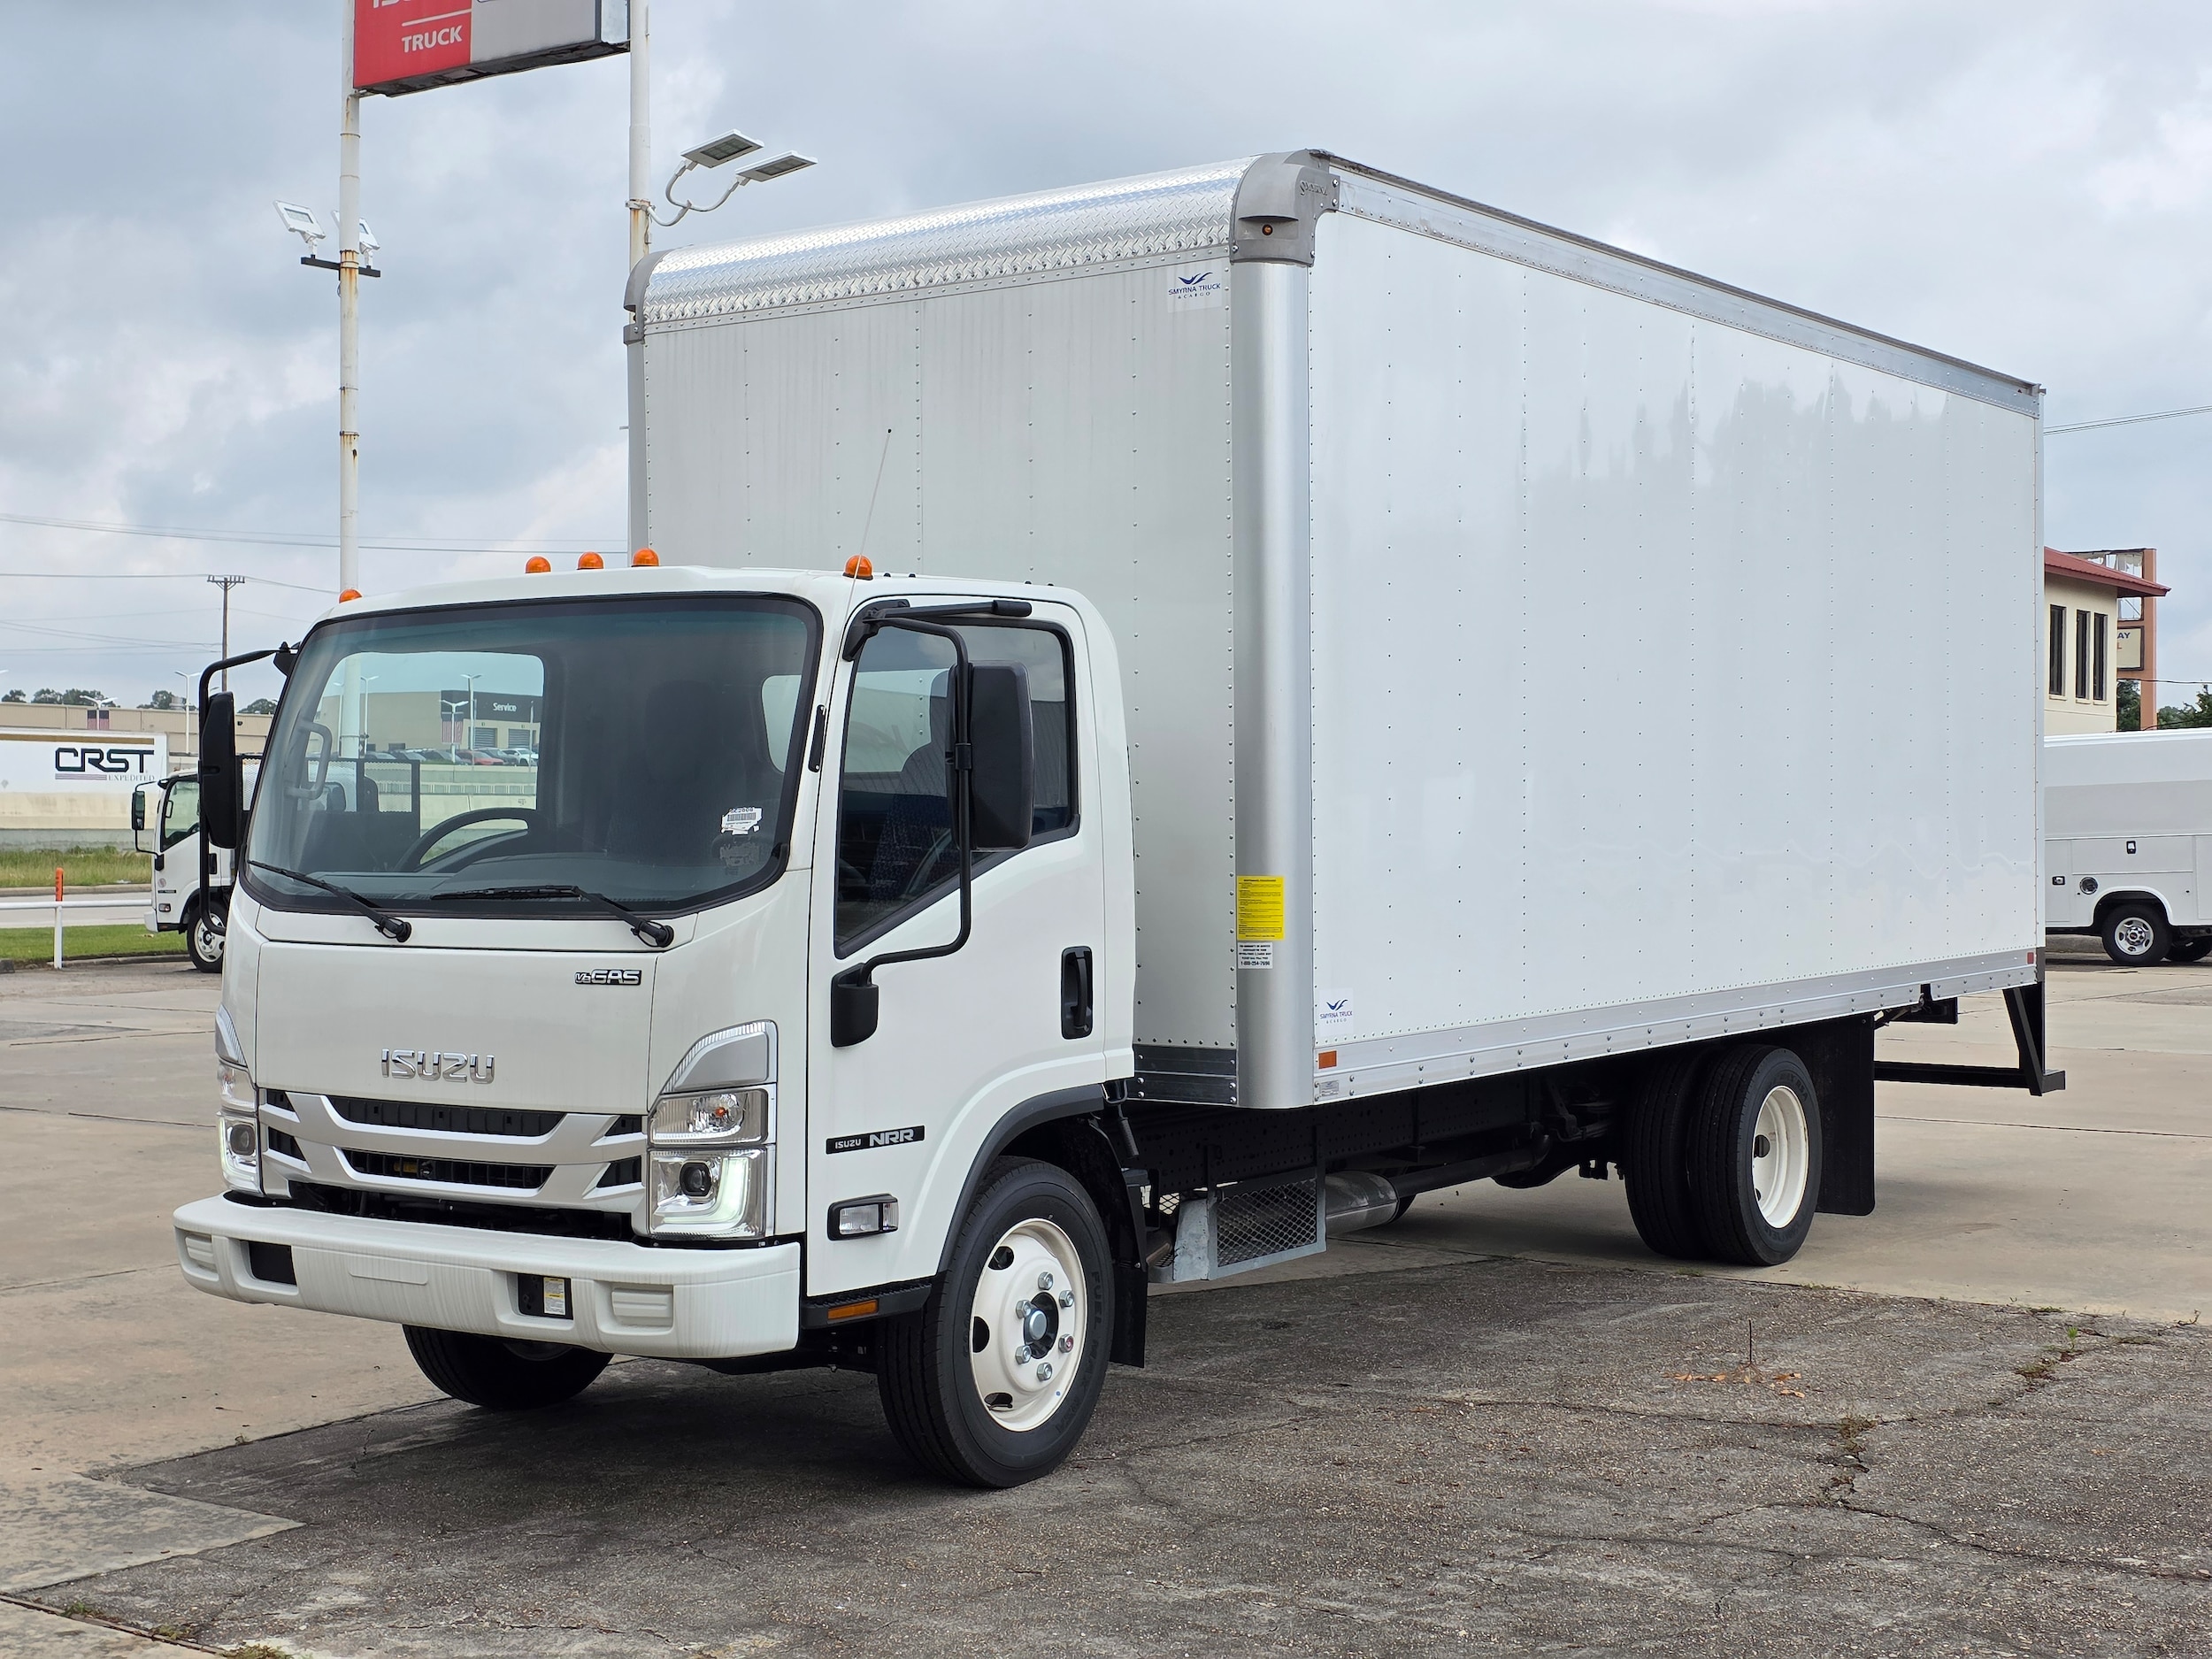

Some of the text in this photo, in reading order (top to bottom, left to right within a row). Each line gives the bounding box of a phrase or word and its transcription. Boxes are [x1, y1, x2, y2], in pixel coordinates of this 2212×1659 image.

[402, 25, 463, 53] TRUCK
[1168, 282, 1221, 296] SMYRNA TRUCK
[493, 702, 517, 712] Service
[55, 747, 155, 773] CRST
[591, 970, 641, 985] GAS
[381, 1048, 495, 1084] ISUZU
[834, 1128, 914, 1149] ISUZU NRR
